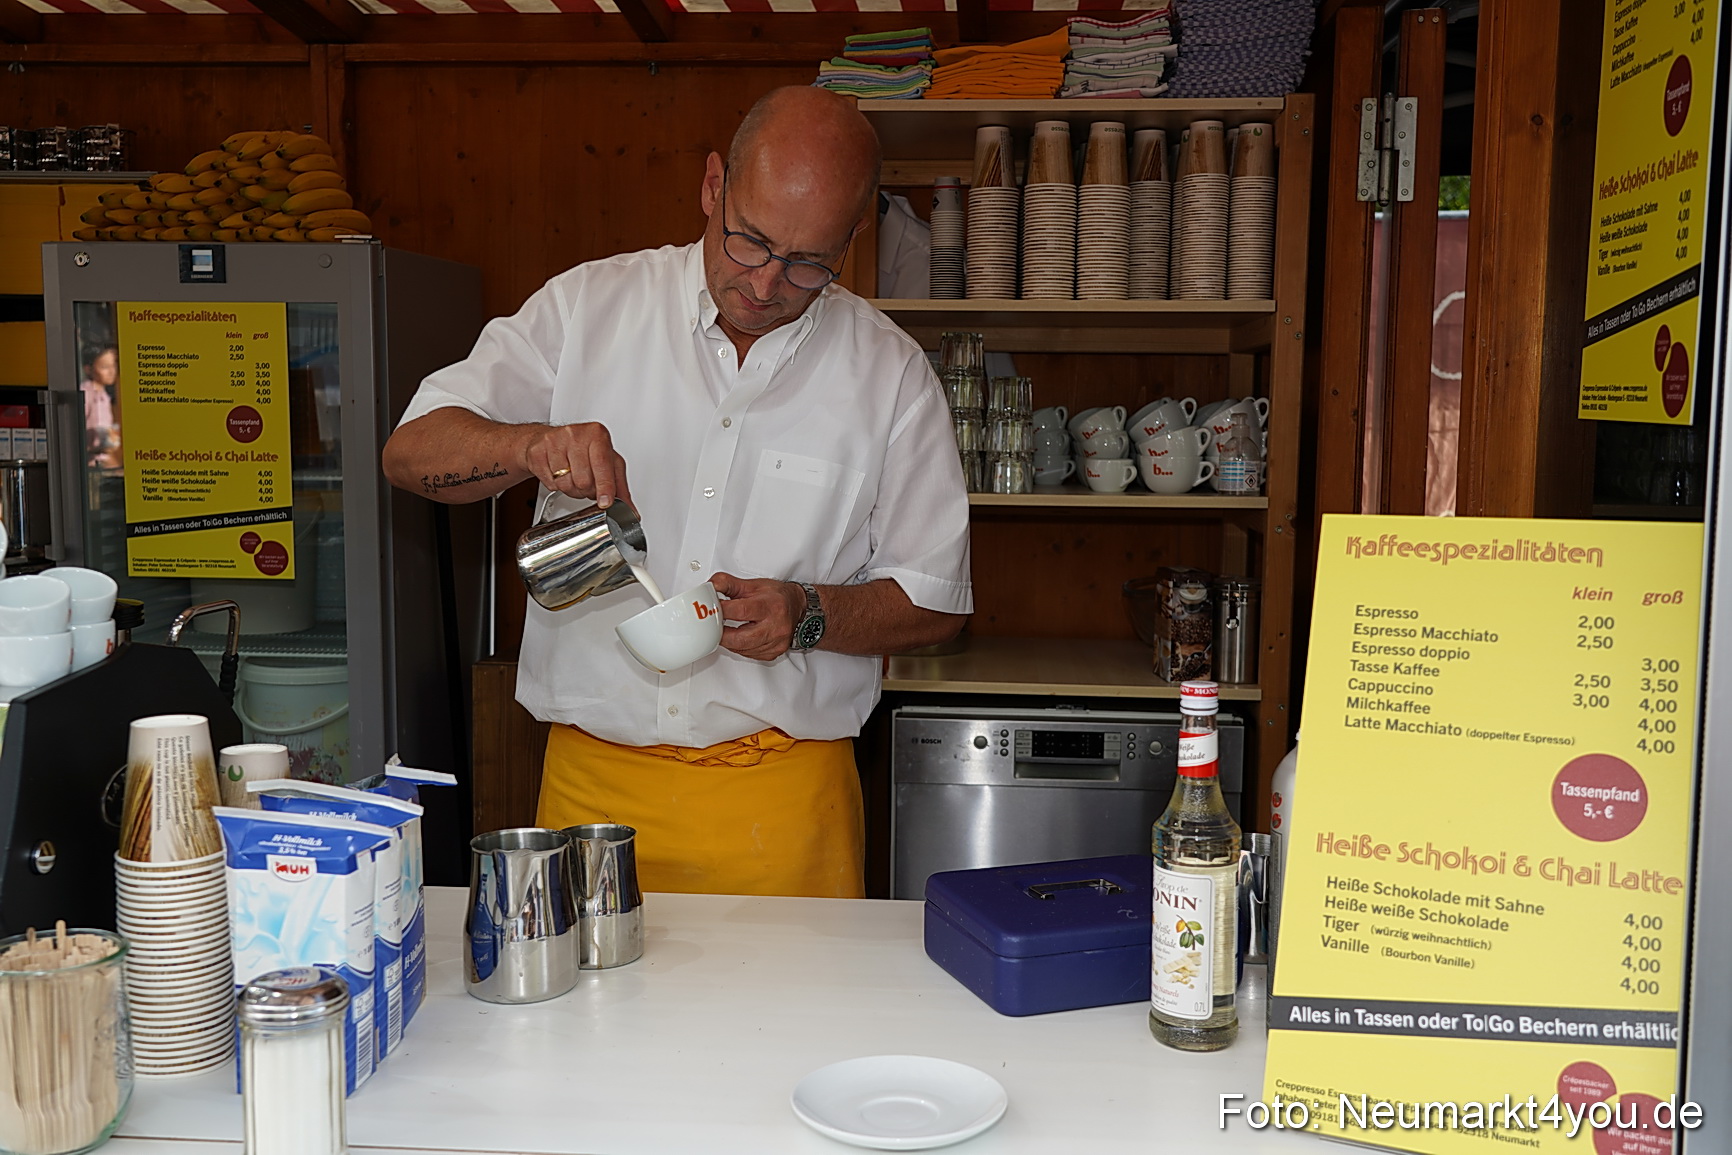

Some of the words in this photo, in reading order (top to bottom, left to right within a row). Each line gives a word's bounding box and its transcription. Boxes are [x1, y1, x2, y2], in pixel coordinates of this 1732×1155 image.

[1599, 176, 1619, 200] Heiße
[1657, 154, 1675, 182] Chai
[1676, 149, 1699, 174] Latte
[129, 310, 237, 324] Kaffeespezialitäten
[137, 344, 165, 352] Espresso
[253, 332, 269, 340] groß
[138, 353, 166, 361] Espresso
[139, 379, 175, 387] Cappuccino
[256, 371, 270, 379] 3,50
[256, 397, 271, 405] 4,00
[135, 450, 166, 461] Heiße
[169, 450, 212, 462] Schokoi
[215, 451, 222, 461] &
[225, 451, 249, 463] Chai
[251, 451, 278, 462] Latte
[134, 525, 151, 534] Alles
[161, 522, 184, 531] Tassen
[186, 520, 201, 528] oder
[224, 516, 253, 525] Bechern
[254, 511, 287, 522] erhältlich
[1346, 534, 1604, 568] Kaffeespezialitäten
[1572, 586, 1613, 602] klein
[1641, 588, 1684, 606] groß
[1355, 604, 1419, 621] Espresso
[1578, 615, 1615, 632] 2,00
[1353, 623, 1417, 640] Espresso
[1421, 626, 1499, 643] Macchiato
[1576, 634, 1614, 651] 2,50
[1351, 641, 1416, 659] Espresso
[1419, 644, 1470, 662] doppio
[1641, 658, 1680, 675] 3,00
[1349, 660, 1390, 674] Tasse
[1393, 662, 1440, 678] Kaffee
[1573, 673, 1611, 691] 2,50
[1640, 677, 1679, 695] 3,50
[1348, 678, 1434, 698] Cappuccino
[1572, 693, 1610, 710] 3,00
[1638, 698, 1677, 716] 4,00
[1346, 697, 1431, 716] Milchkaffee
[1637, 718, 1677, 736] 4,00
[1344, 715, 1381, 731] Latte
[1384, 718, 1462, 738] Macchiato
[1465, 727, 1520, 744] (doppelter
[1523, 732, 1575, 747] Espresso)
[1636, 738, 1676, 756] 4,00
[1560, 782, 1640, 802] Tassenpfand
[1604, 805, 1614, 819] €
[1316, 832, 1392, 861] Heiße
[1396, 842, 1507, 876] Schokoi
[1513, 855, 1532, 877] &
[1539, 856, 1600, 887] Chai
[1608, 862, 1683, 895] Latte
[1326, 876, 1369, 893] Heiße
[1373, 882, 1461, 905] Schokolade
[1465, 894, 1490, 909] mit
[1495, 896, 1545, 915] Sahne
[1624, 913, 1663, 930] 4,00
[1324, 895, 1367, 913] Heiße
[1371, 904, 1414, 920] weiße
[1418, 907, 1509, 932] Schokolade
[1622, 935, 1662, 952] 4,00
[1323, 915, 1359, 932] Tiger
[1370, 924, 1410, 940] (würzig
[1412, 930, 1492, 951] weihnachtlich)
[1621, 956, 1660, 973] 4,00
[1321, 935, 1370, 953] Vanille
[1381, 946, 1431, 963] (Bourbon
[1434, 953, 1475, 969] Vanille)
[1620, 978, 1659, 995] 4,00
[1289, 1006, 1330, 1024] Alles
[1335, 1008, 1350, 1025] in
[1354, 1009, 1414, 1028] Tassen
[1418, 1012, 1459, 1030] oder
[1519, 1016, 1598, 1037] Bechern
[1275, 1078, 1326, 1097] Creppresso
[1491, 1131, 1541, 1149] Neumarkt
[1623, 1141, 1637, 1150] auf
